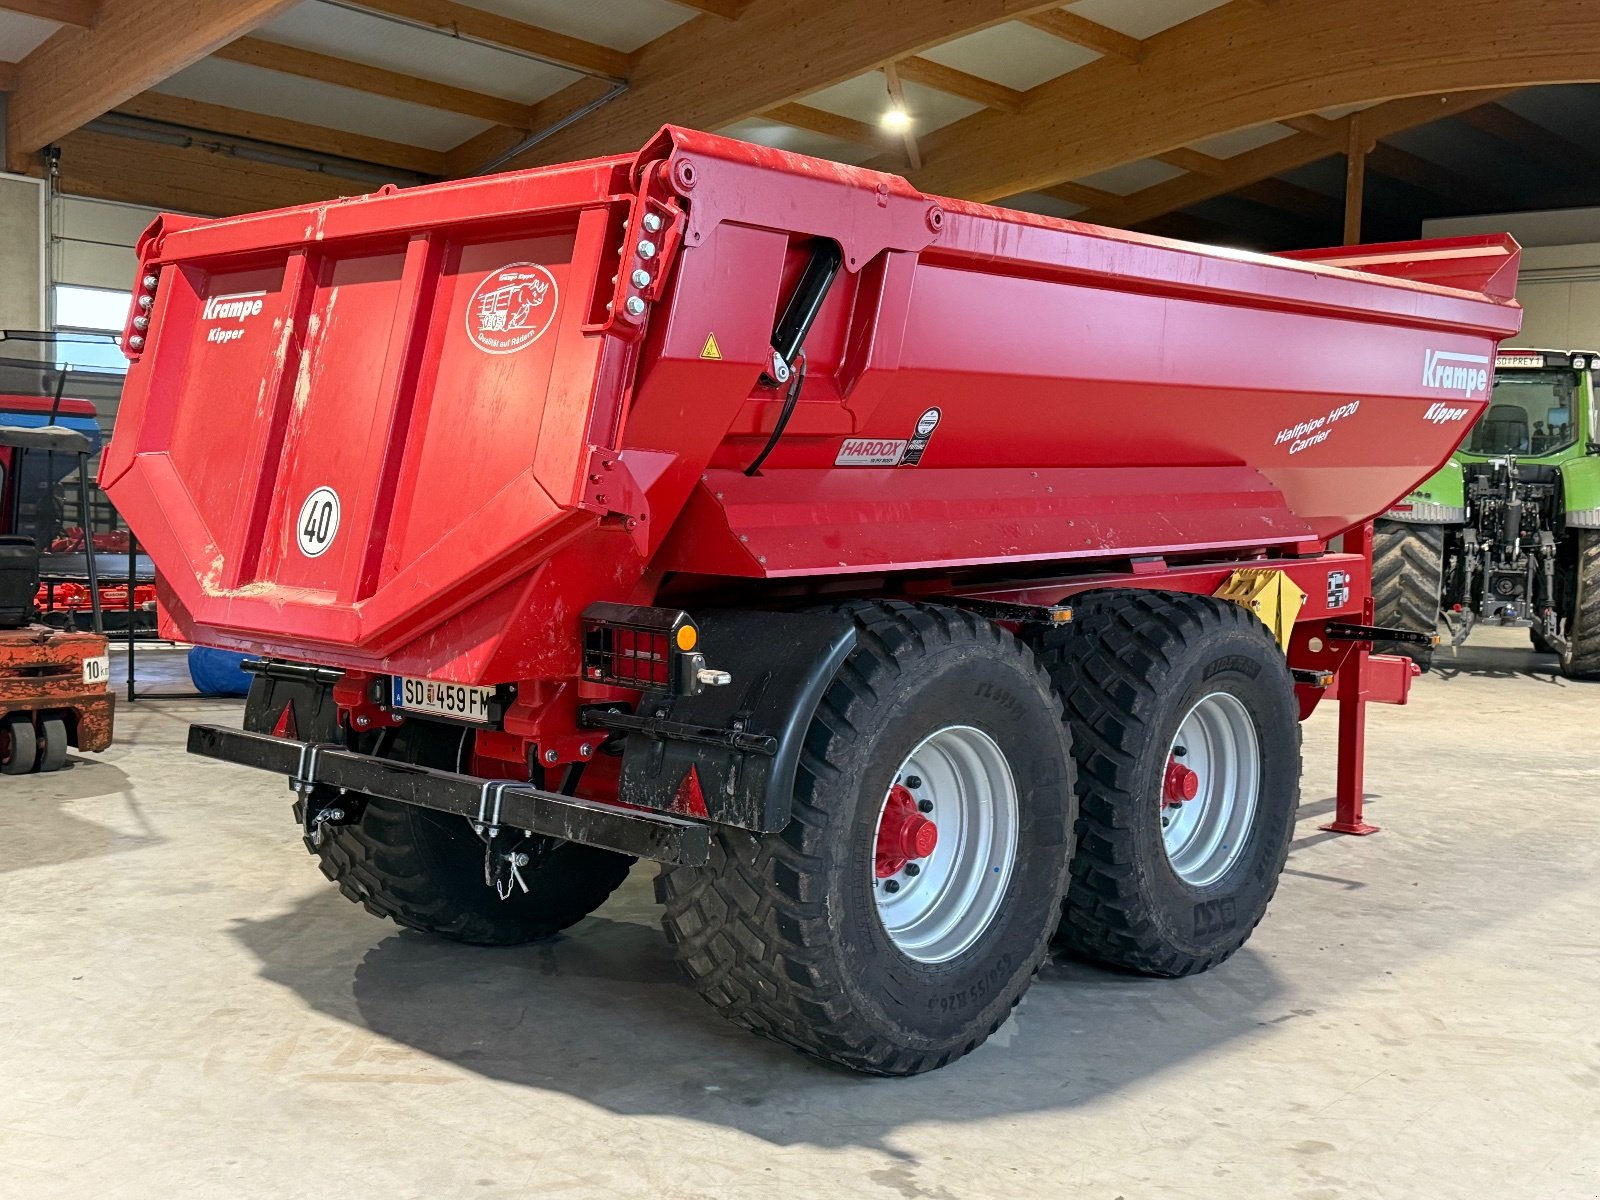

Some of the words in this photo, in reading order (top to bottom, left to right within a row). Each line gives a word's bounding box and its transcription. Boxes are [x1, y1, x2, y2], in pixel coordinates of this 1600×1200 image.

[202, 290, 266, 322] Krampe
[207, 327, 245, 344] Kipper
[477, 332, 499, 347] Qualität
[500, 340, 510, 348] auf
[511, 329, 536, 346] Rädern
[1496, 356, 1507, 366] SD
[1422, 349, 1489, 398] Krampe
[1274, 416, 1326, 446] Halfpipe
[1326, 400, 1360, 425] HP20
[1423, 402, 1469, 424] Kipper
[840, 441, 901, 456] HARDOX
[1289, 429, 1332, 455] Carrier
[303, 500, 333, 544] 40
[86, 660, 99, 680] 10
[405, 679, 424, 705] SD
